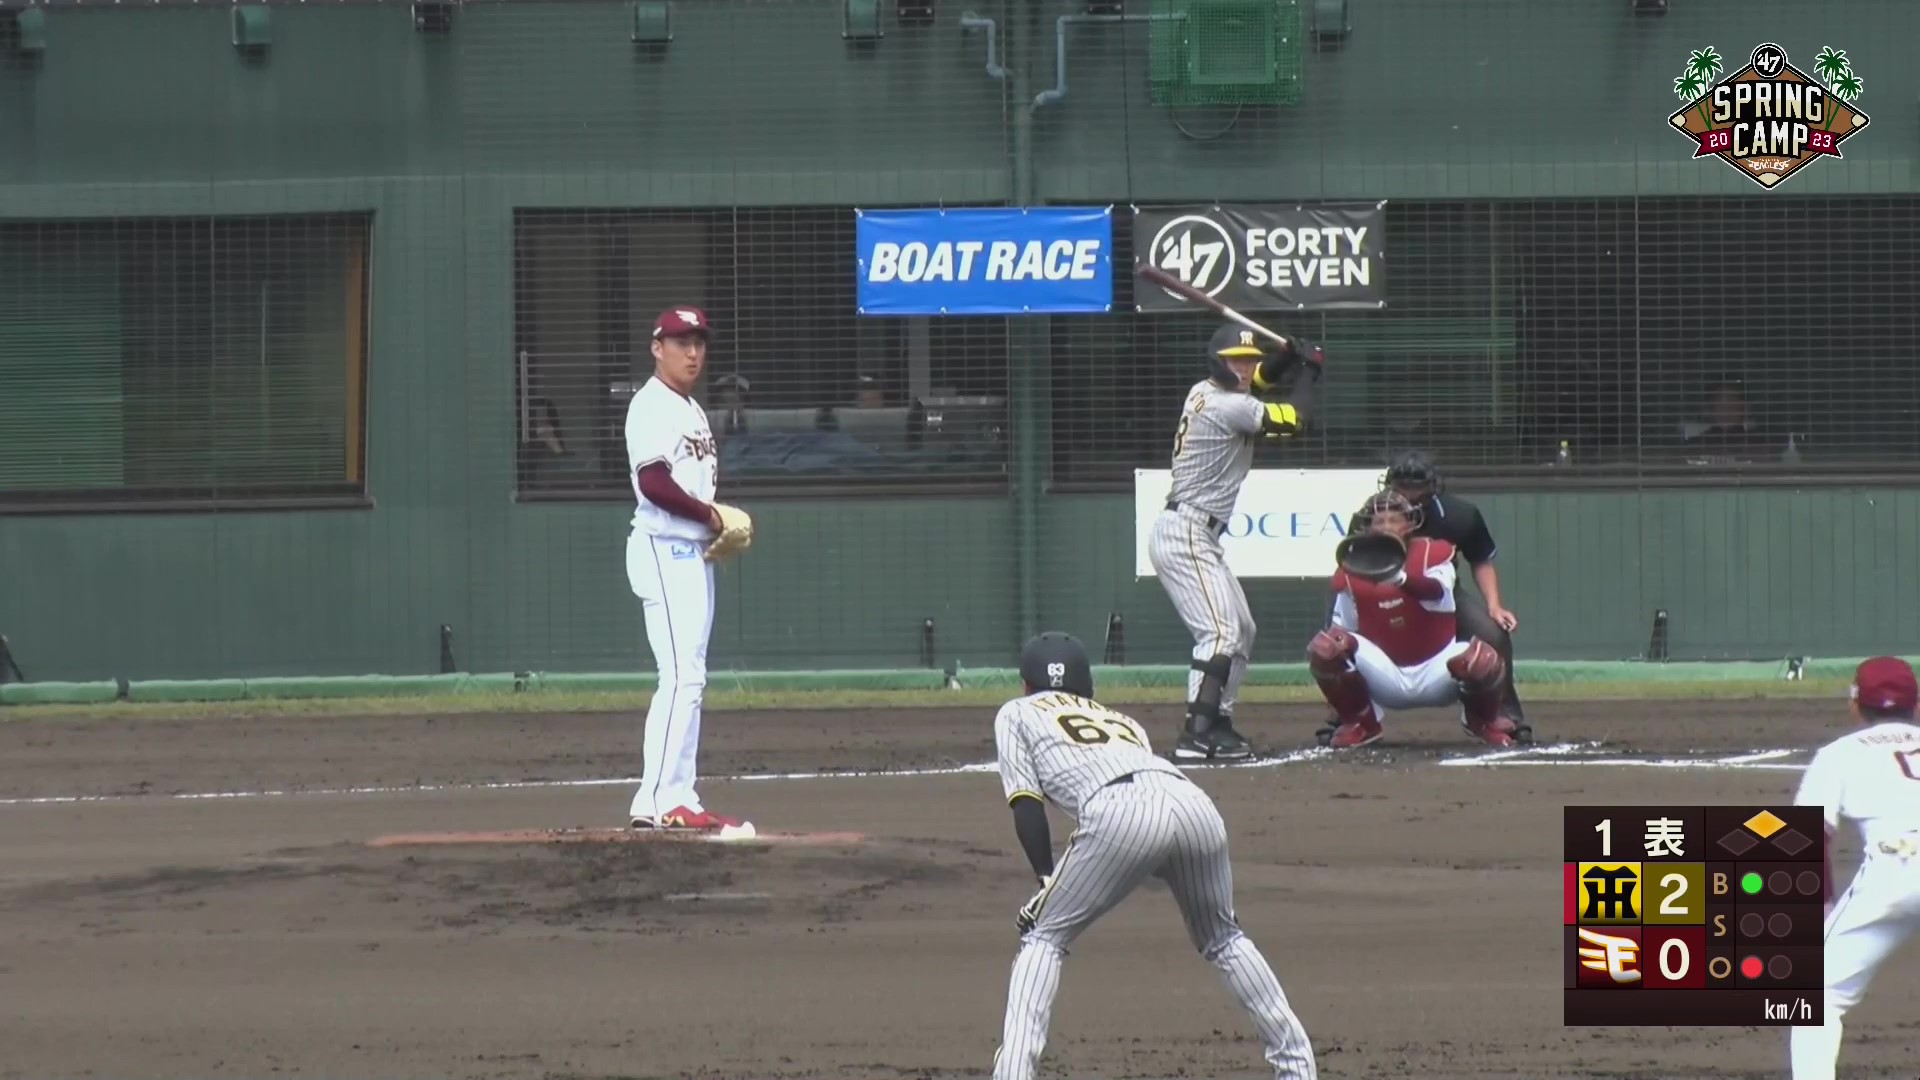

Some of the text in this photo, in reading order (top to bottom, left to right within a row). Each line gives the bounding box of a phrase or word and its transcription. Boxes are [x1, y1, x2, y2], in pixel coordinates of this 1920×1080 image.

[1246, 226, 1368, 257] FORTY
[868, 239, 1100, 282] BOAT RACE
[1246, 257, 1370, 288] SEVEN
[1225, 512, 1347, 537] OCEA
[1057, 714, 1144, 747] 63
